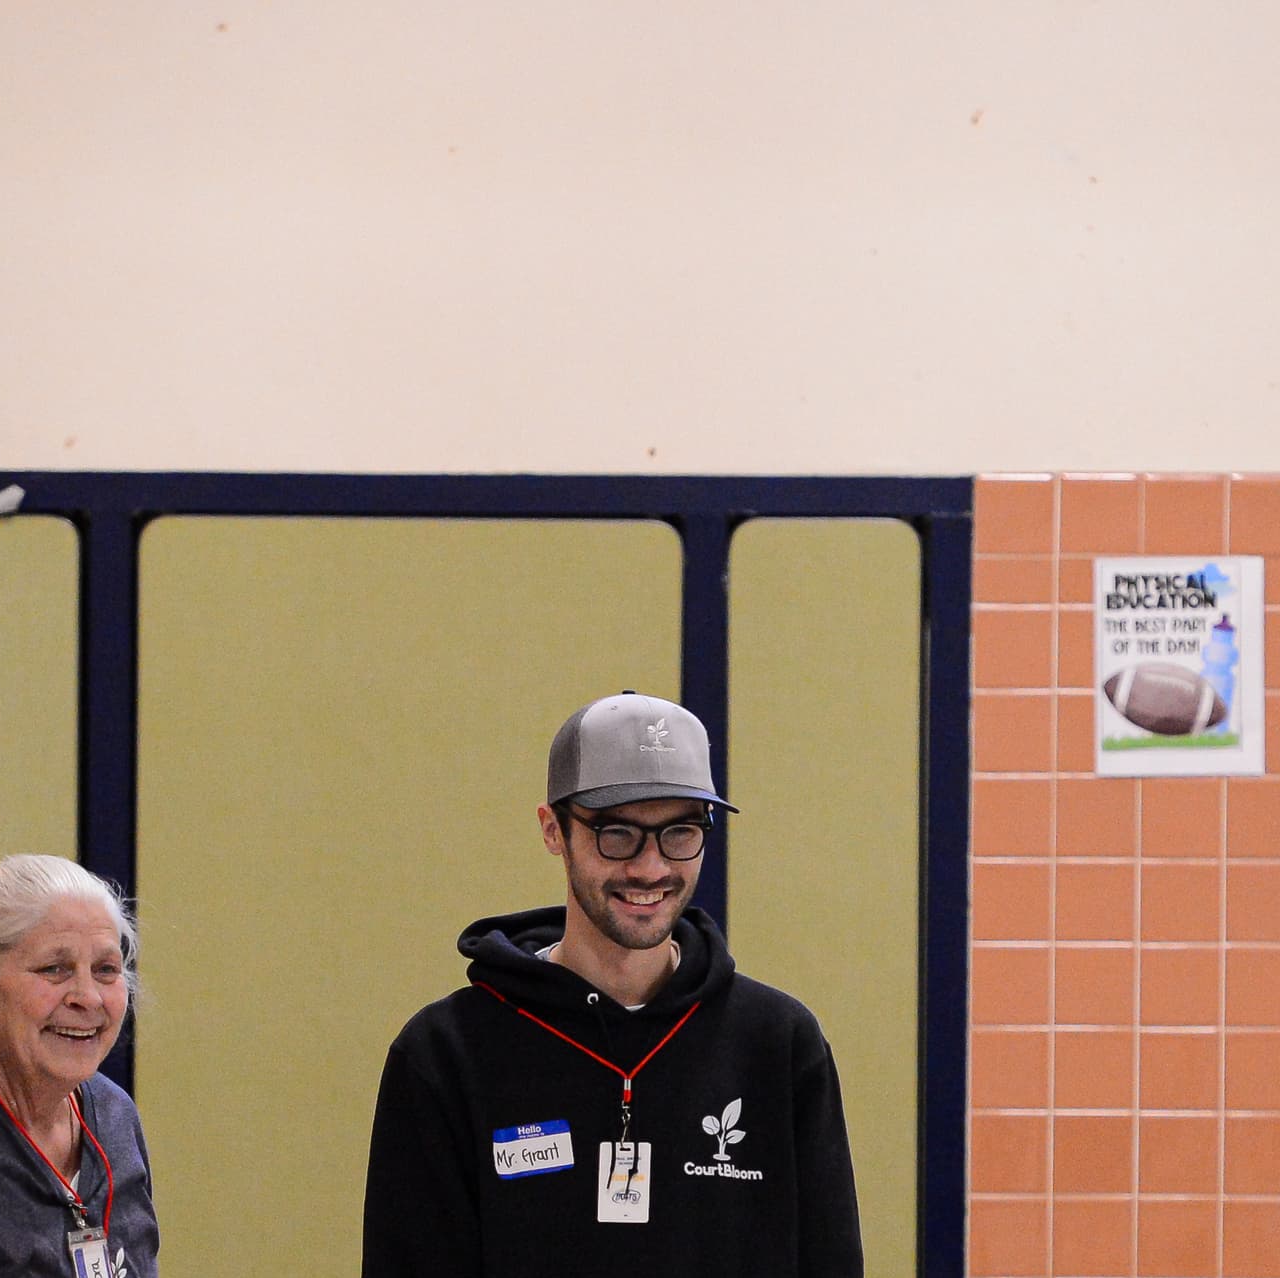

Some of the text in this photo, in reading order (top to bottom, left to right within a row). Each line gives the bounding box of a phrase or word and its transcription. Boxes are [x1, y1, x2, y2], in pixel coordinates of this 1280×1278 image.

[1114, 572, 1207, 590] PHYSICAL
[1106, 592, 1217, 609] EDUCATION
[1104, 617, 1207, 633] THE BEST PART
[1112, 639, 1129, 655] OF
[1136, 639, 1159, 655] THE
[517, 1125, 542, 1136] Hello
[522, 1142, 560, 1166] Grant
[683, 1161, 763, 1181] CourtBloom
